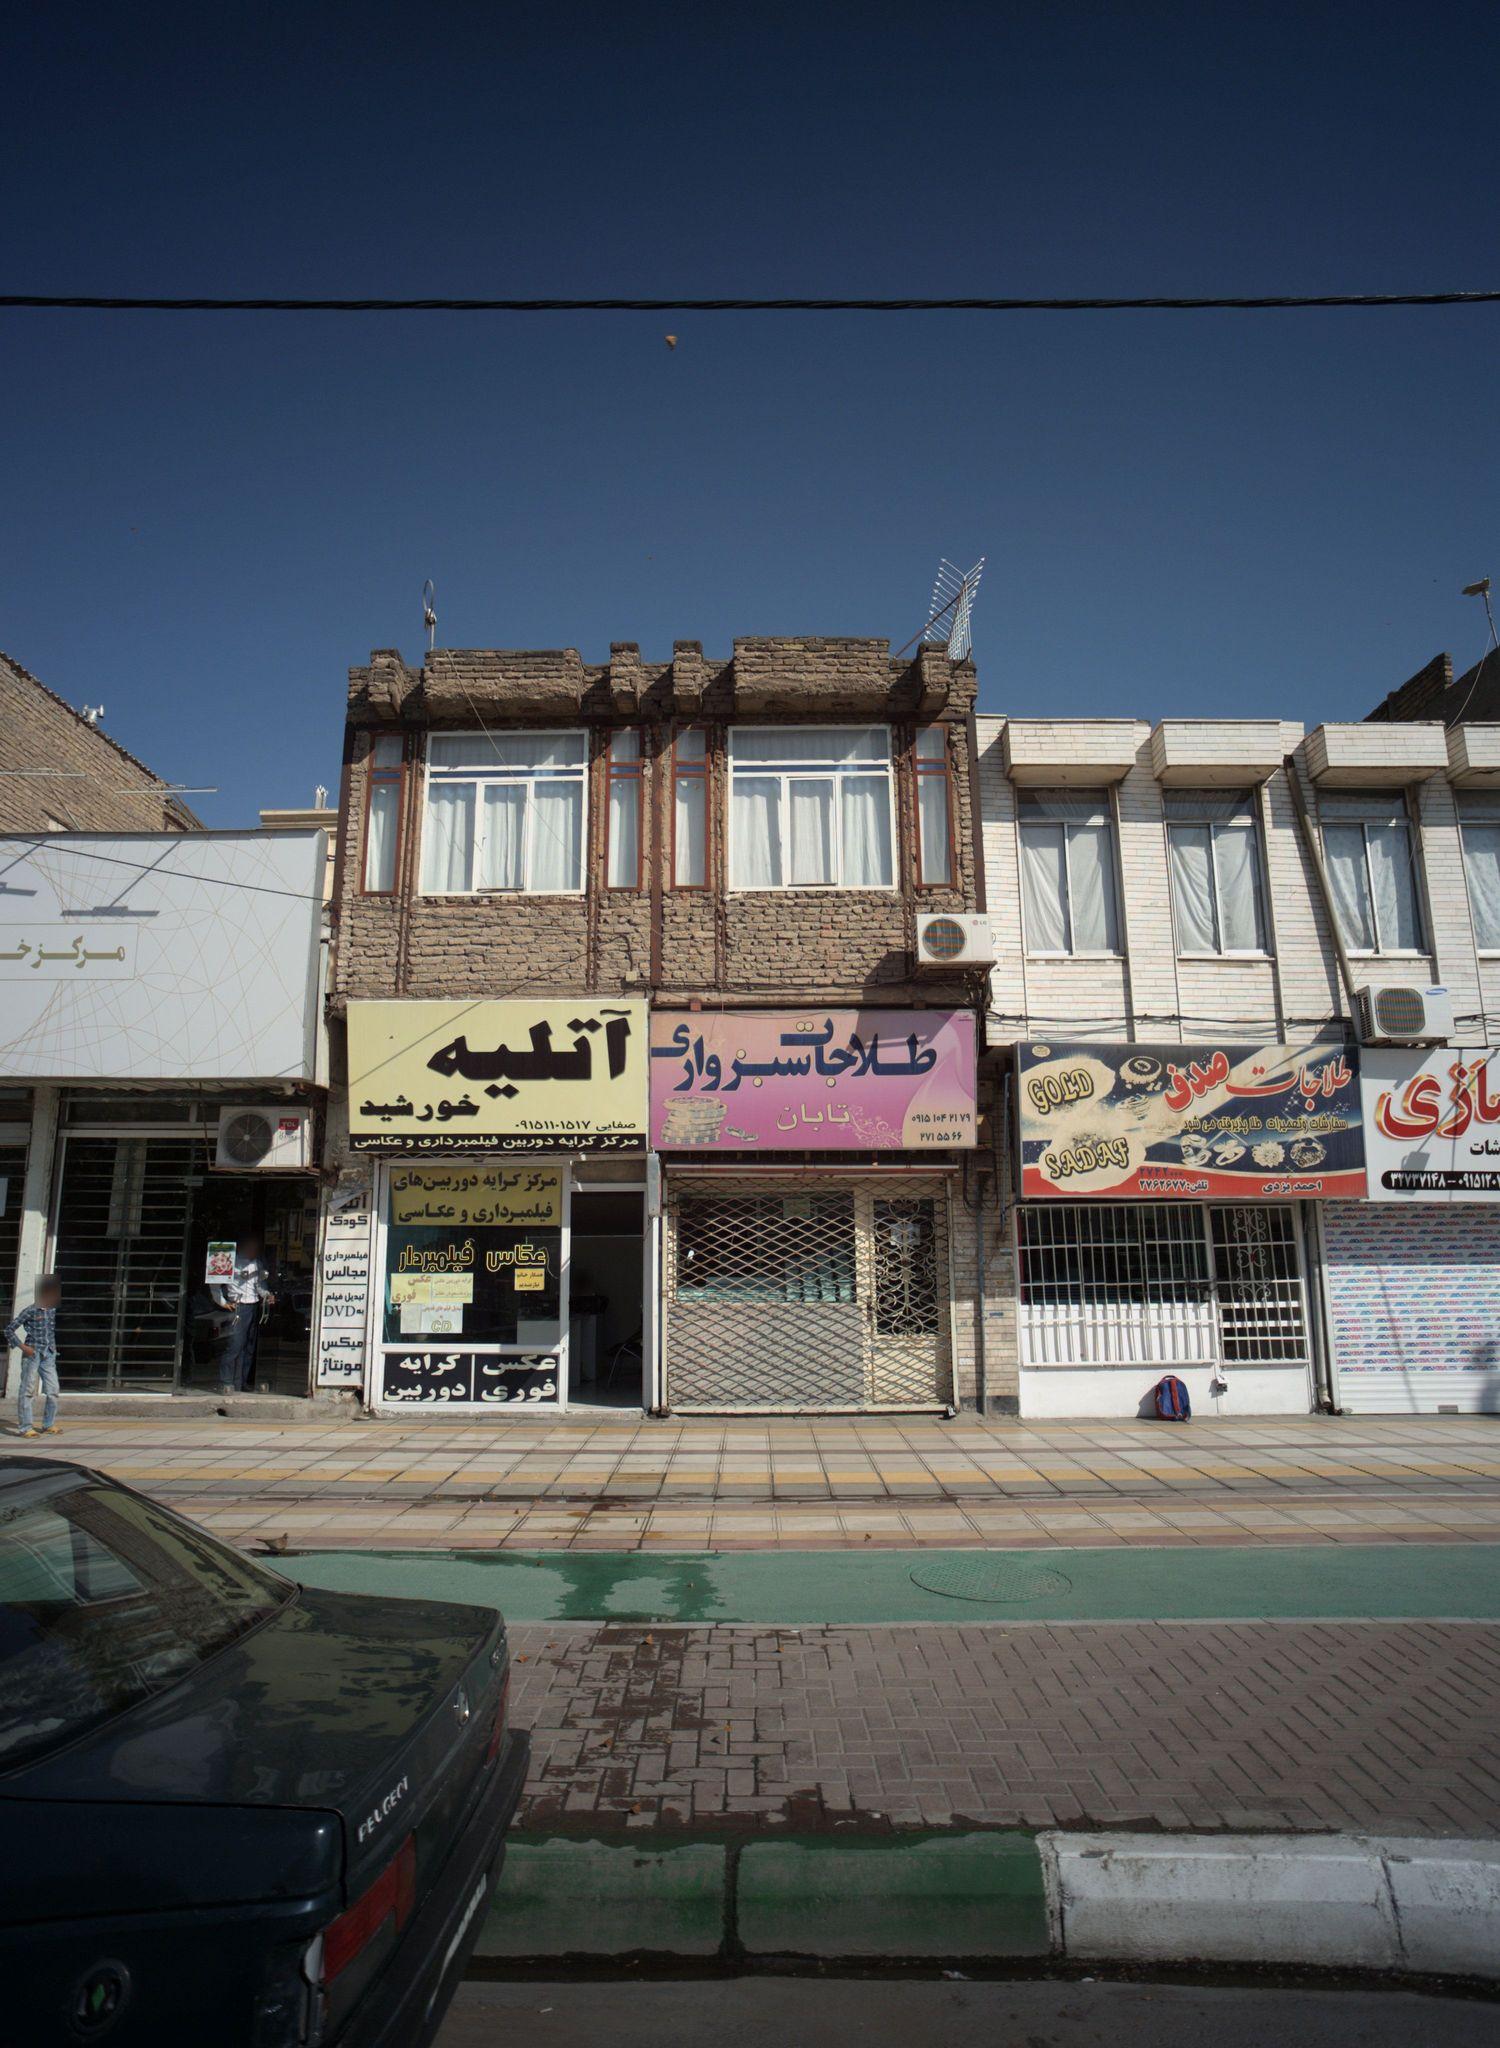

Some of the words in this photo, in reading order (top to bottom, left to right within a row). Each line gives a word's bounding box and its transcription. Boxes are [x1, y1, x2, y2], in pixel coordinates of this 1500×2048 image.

[31, 935, 125, 969] مرکز
[427, 1009, 632, 1099] آتلیه
[651, 1023, 812, 1091] سبزواری
[780, 1017, 938, 1087] طلاجات
[1163, 1051, 1230, 1112] صدف
[1225, 1054, 1352, 1112] طلاجات
[1028, 1068, 1094, 1115] GOLD
[1376, 1057, 1500, 1141] ازی
[360, 1094, 480, 1121] خورشید
[515, 1120, 591, 1130] ۰۹۱۵۱۱۰۱۵۱۷
[776, 1102, 850, 1131] تابان
[1184, 1115, 1201, 1132] شود
[1202, 1117, 1216, 1132] می
[1217, 1115, 1250, 1135] پذیرفته
[1249, 1116, 1262, 1130] طلا
[1309, 1113, 1348, 1133] سفارشات
[596, 1120, 637, 1132] صفایی
[354, 1135, 402, 1148] عکاسی
[405, 1138, 414, 1149] و
[418, 1135, 498, 1148] فیلمبرداری
[502, 1136, 554, 1149] دوربین
[558, 1135, 597, 1148] کرایه
[601, 1135, 639, 1148] مرکز
[1045, 1137, 1129, 1179] SADAF
[483, 1172, 521, 1191] کرایه
[524, 1171, 558, 1192] مرکز
[1262, 1180, 1291, 1193] یزدی
[1293, 1179, 1322, 1191] احمد
[338, 1192, 369, 1213] آتلی
[398, 1203, 455, 1223] عکاسی
[459, 1208, 468, 1223] و
[472, 1202, 553, 1223] فیلمبرداری
[330, 1215, 368, 1229] کودک
[325, 1251, 368, 1262] فیلمبرداری
[399, 1240, 474, 1273] فیلمبردار
[486, 1244, 547, 1272] عکاس
[325, 1265, 367, 1281] مجالس
[407, 1274, 432, 1286] عکس
[325, 1292, 343, 1303] فیلم
[344, 1292, 365, 1303] تبدیل
[391, 1289, 416, 1303] فوری
[323, 1305, 356, 1317] DVD
[356, 1308, 365, 1316] به
[431, 1320, 452, 1332] CD
[321, 1337, 364, 1352] میکس
[320, 1358, 362, 1376] مونتاژ
[399, 1354, 460, 1376] کرایه
[482, 1354, 557, 1375] عکس
[384, 1383, 466, 1401] دوربین
[481, 1378, 557, 1401] فوری
